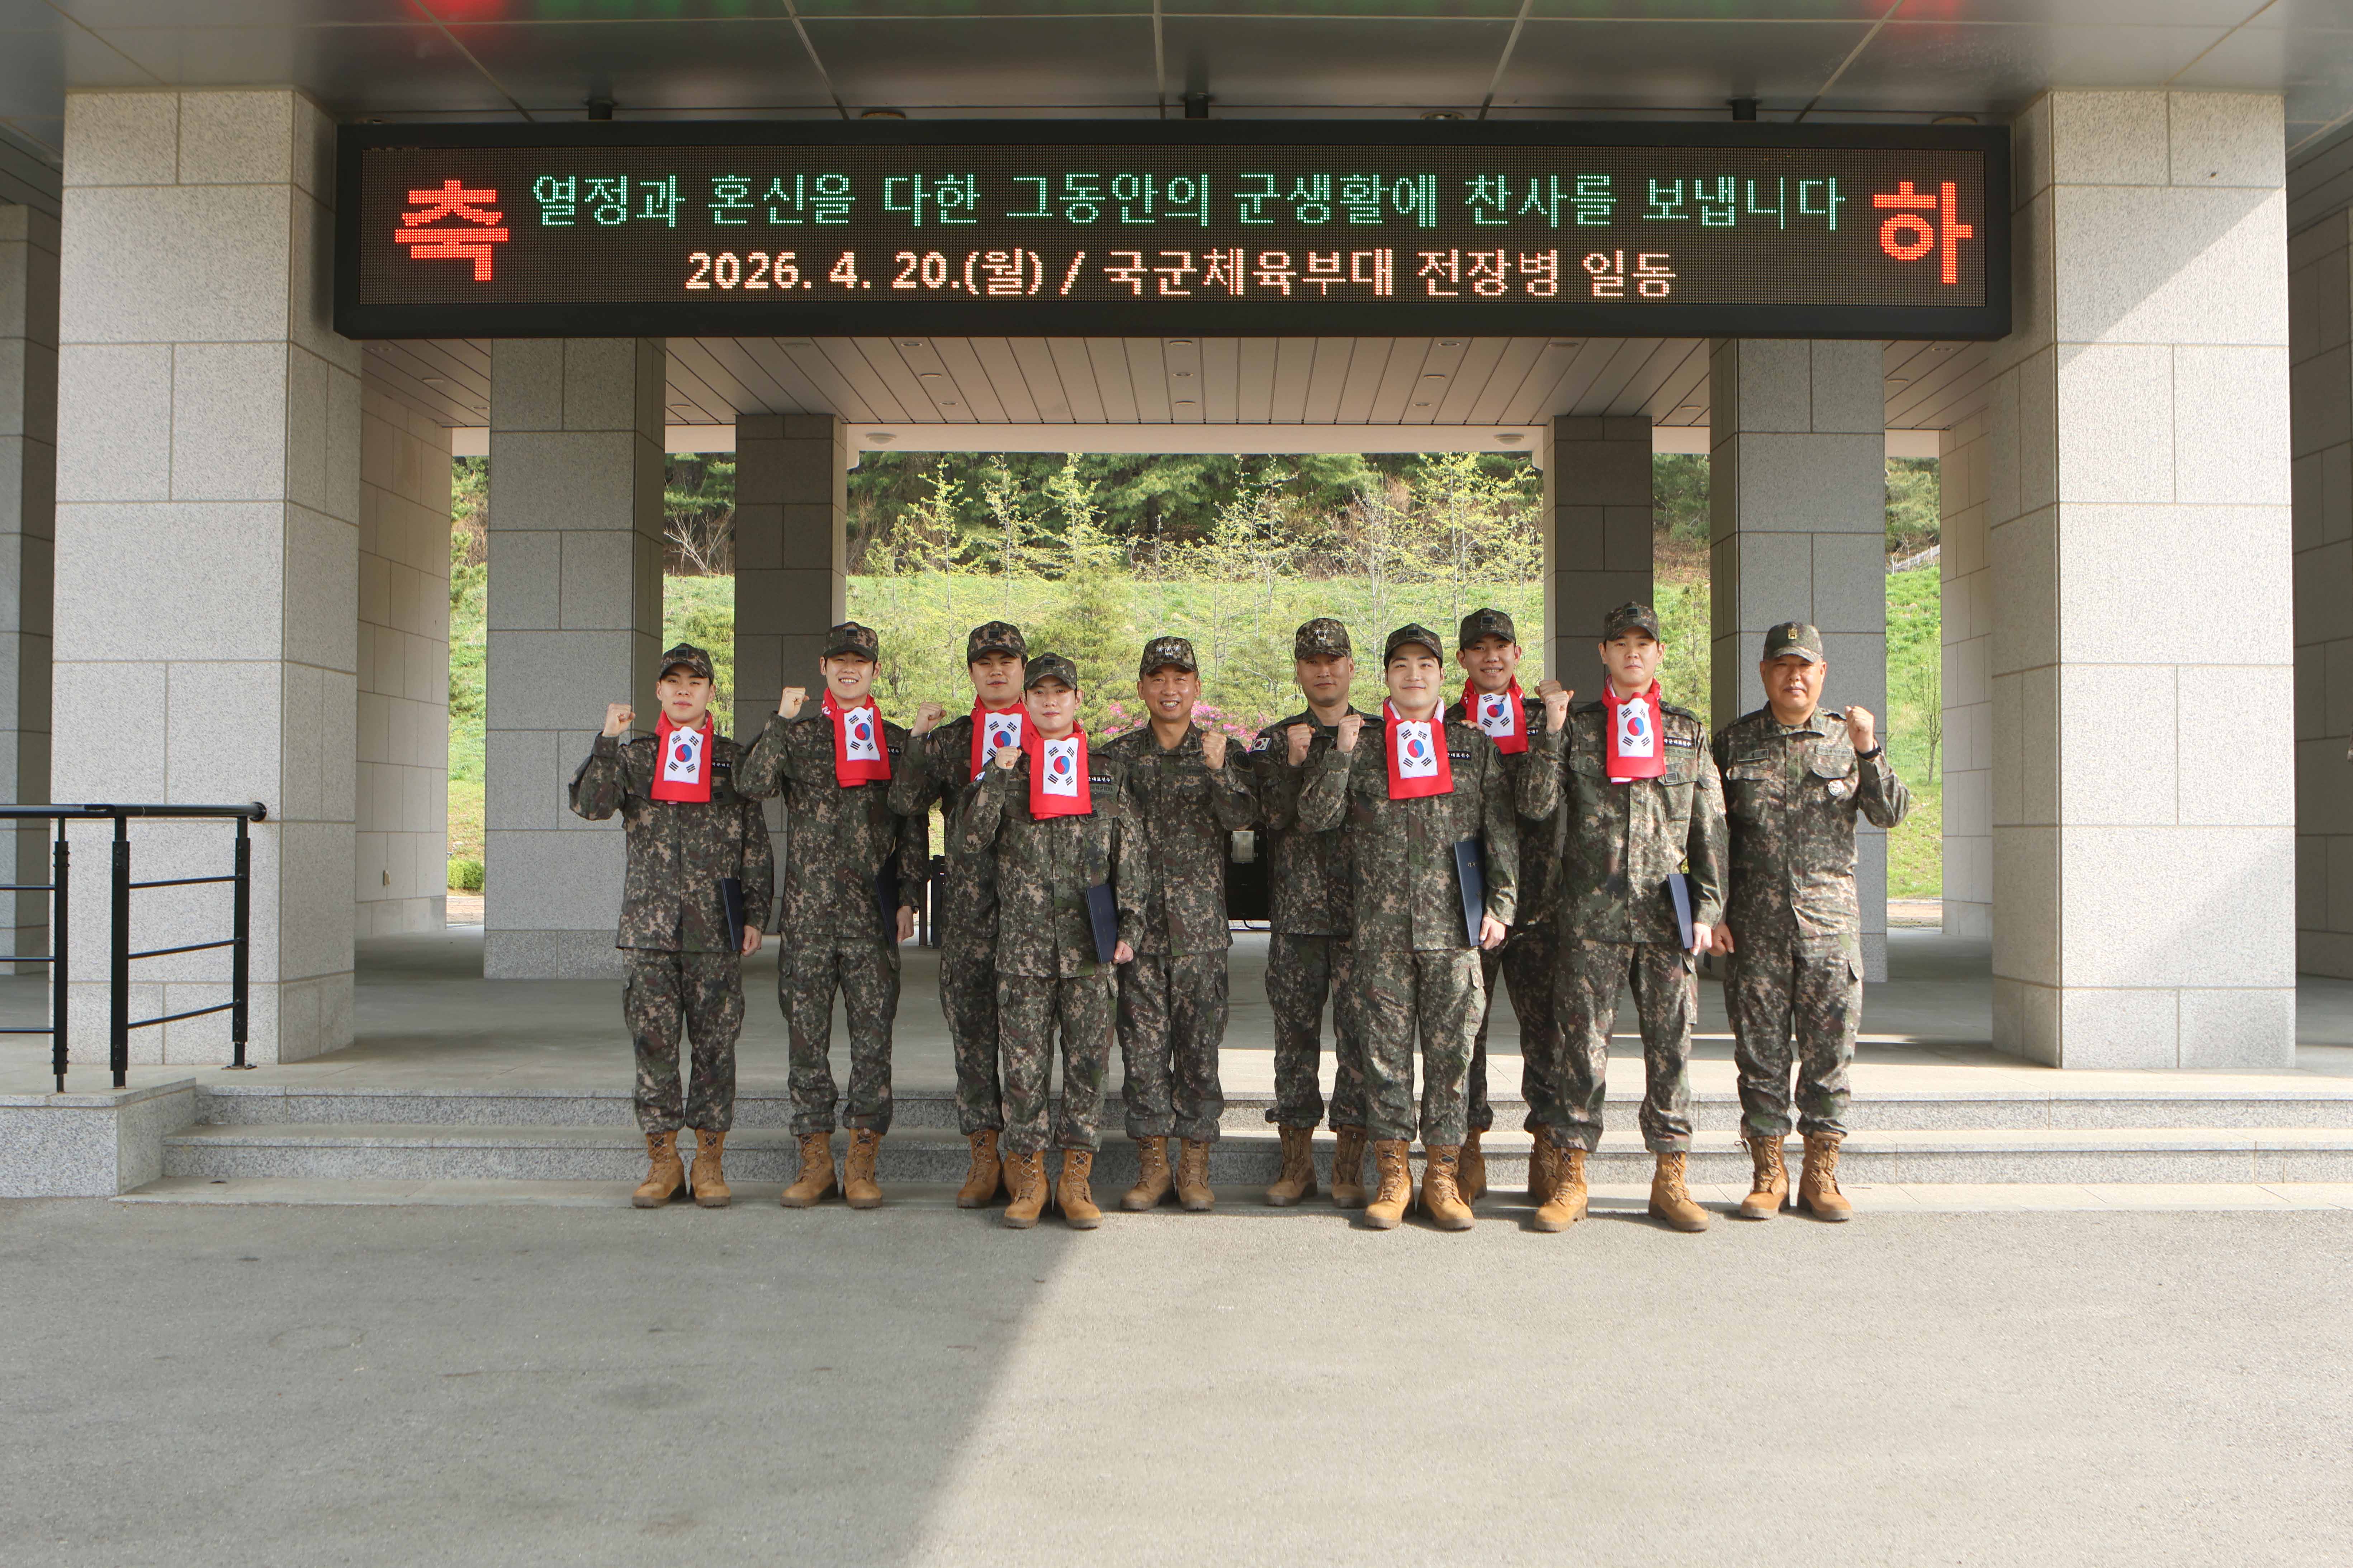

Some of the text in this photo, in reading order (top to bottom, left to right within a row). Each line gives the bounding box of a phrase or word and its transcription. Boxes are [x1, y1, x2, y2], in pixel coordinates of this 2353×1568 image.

[394, 179, 510, 282] 축
[532, 173, 1846, 231] 열정과 혼신을 다한 그동안의 군생활에 찬사를 보냅니다
[1872, 181, 1973, 285] 하
[685, 248, 1677, 298] 2026. 4. 20.(월) / 국군체육부대 전장병 일동
